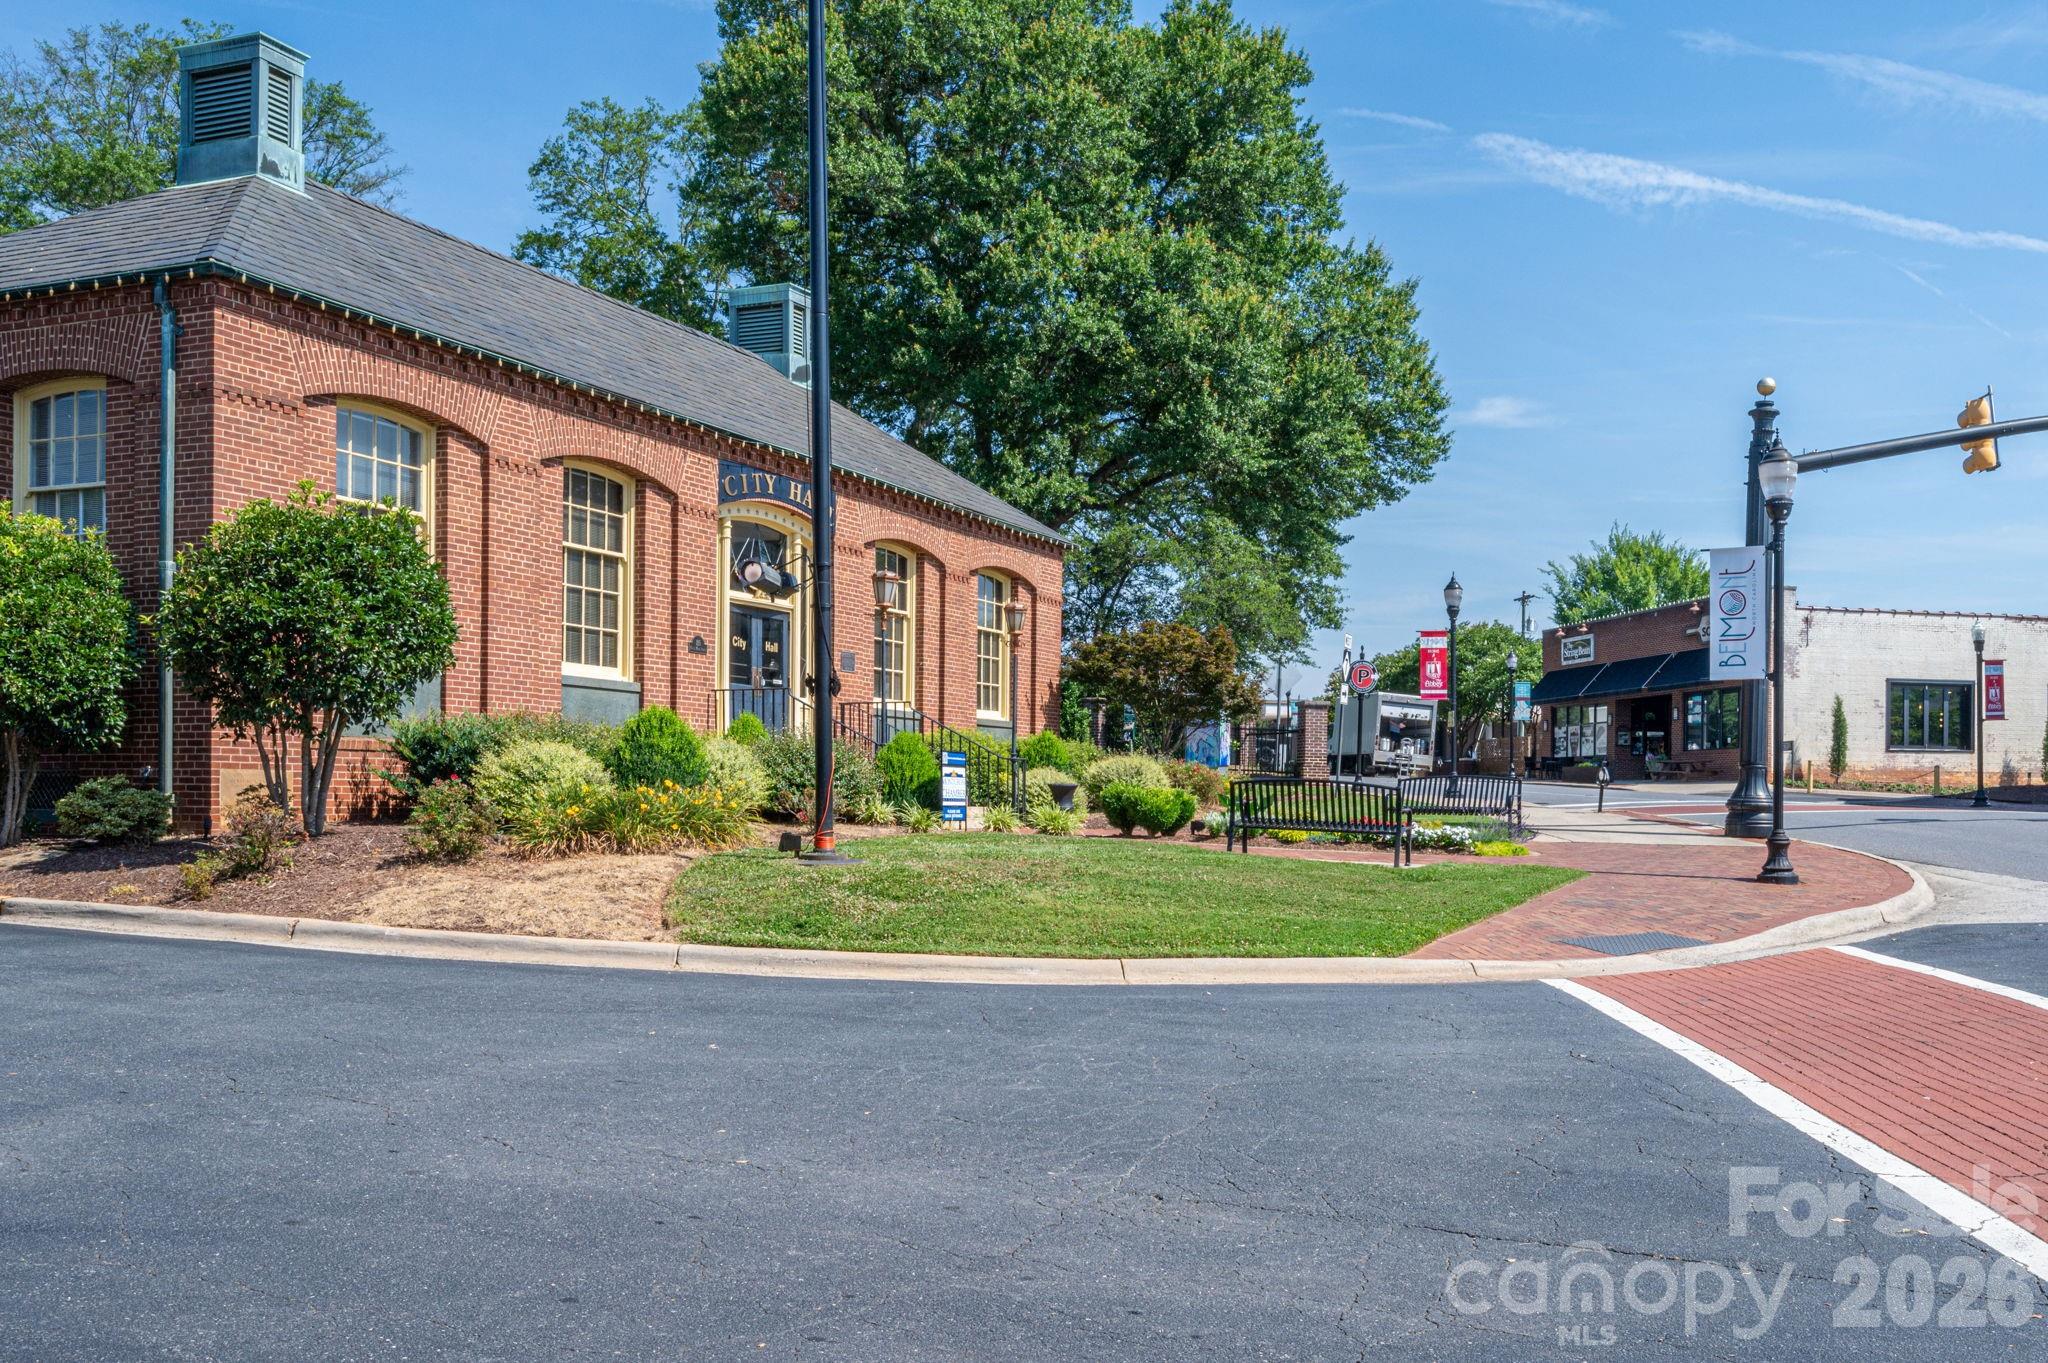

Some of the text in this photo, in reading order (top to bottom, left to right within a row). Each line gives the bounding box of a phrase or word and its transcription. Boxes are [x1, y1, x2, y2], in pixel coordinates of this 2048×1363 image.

[724, 473, 777, 496] CITY
[732, 635, 779, 653] City Hall
[1357, 669, 1370, 683] P
